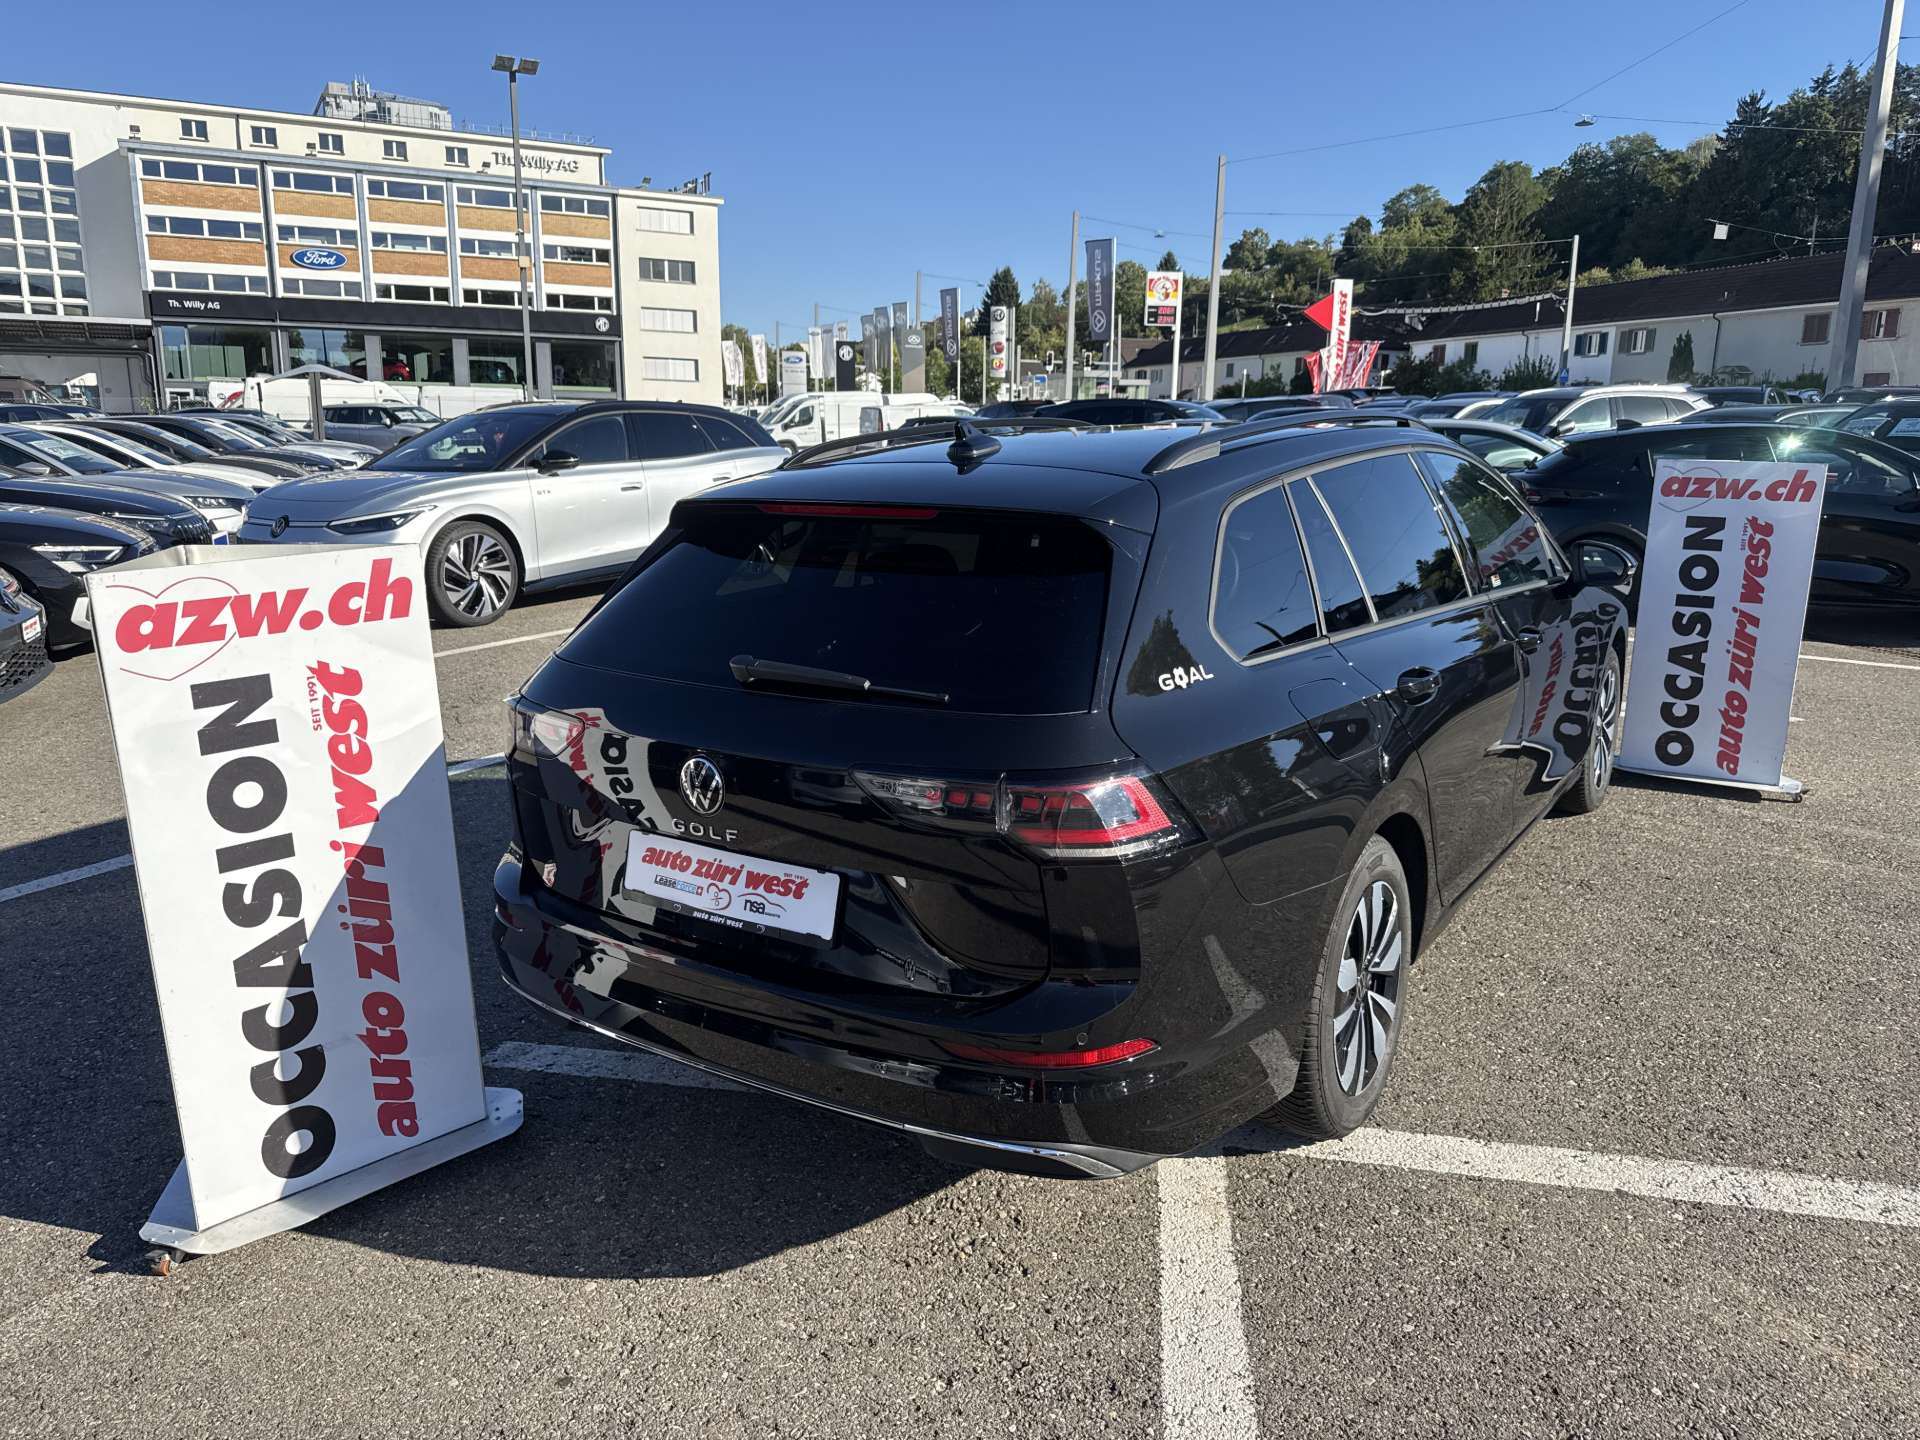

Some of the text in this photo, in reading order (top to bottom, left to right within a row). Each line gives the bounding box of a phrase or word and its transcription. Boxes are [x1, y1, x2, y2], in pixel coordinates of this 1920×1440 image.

[303, 250, 337, 266] Ford
[168, 299, 221, 311] Th. Willy AG
[1660, 469, 1818, 503] azw.ch
[115, 557, 414, 655] azw.ch
[1654, 515, 1727, 767] OCCASION
[1716, 516, 1774, 776] auto züri west
[306, 675, 323, 732] SEIT 1991
[671, 818, 739, 842] GOLF
[305, 659, 420, 1138] auto züri west
[641, 846, 810, 900] auto züri west
[189, 672, 336, 1180] OCCASION
[692, 909, 744, 929] auto züri west
[743, 899, 766, 915] nsa
